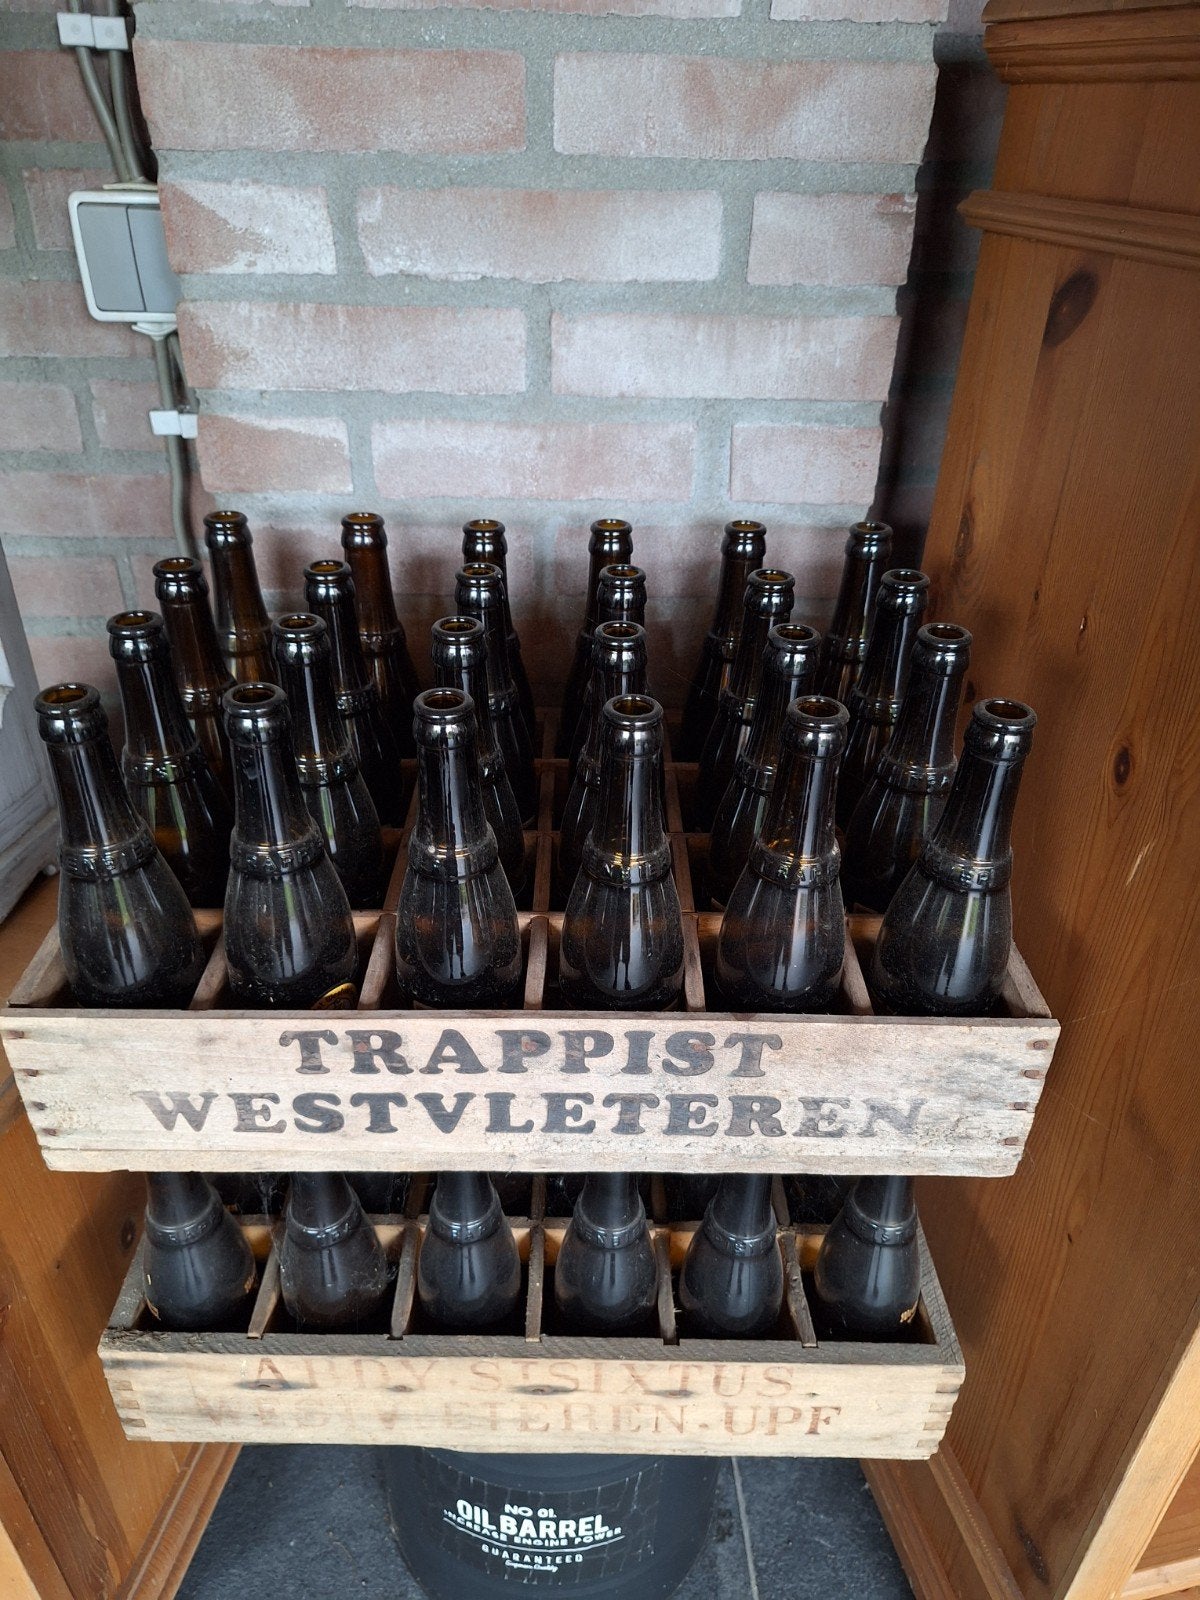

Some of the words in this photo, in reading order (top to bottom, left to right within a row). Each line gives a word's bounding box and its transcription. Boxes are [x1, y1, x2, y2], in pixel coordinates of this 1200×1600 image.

[280, 1029, 783, 1077] TRAPPIST
[132, 1091, 928, 1139] WESTVLETEREN
[443, 1509, 508, 1541] INCREASE
[513, 1537, 568, 1547] ENGINE
[574, 1527, 622, 1545] POWER
[457, 1499, 496, 1531] OIL
[499, 1514, 609, 1539] BARREL
[504, 1503, 533, 1517] NO
[481, 1543, 584, 1565] GUARANTEED
